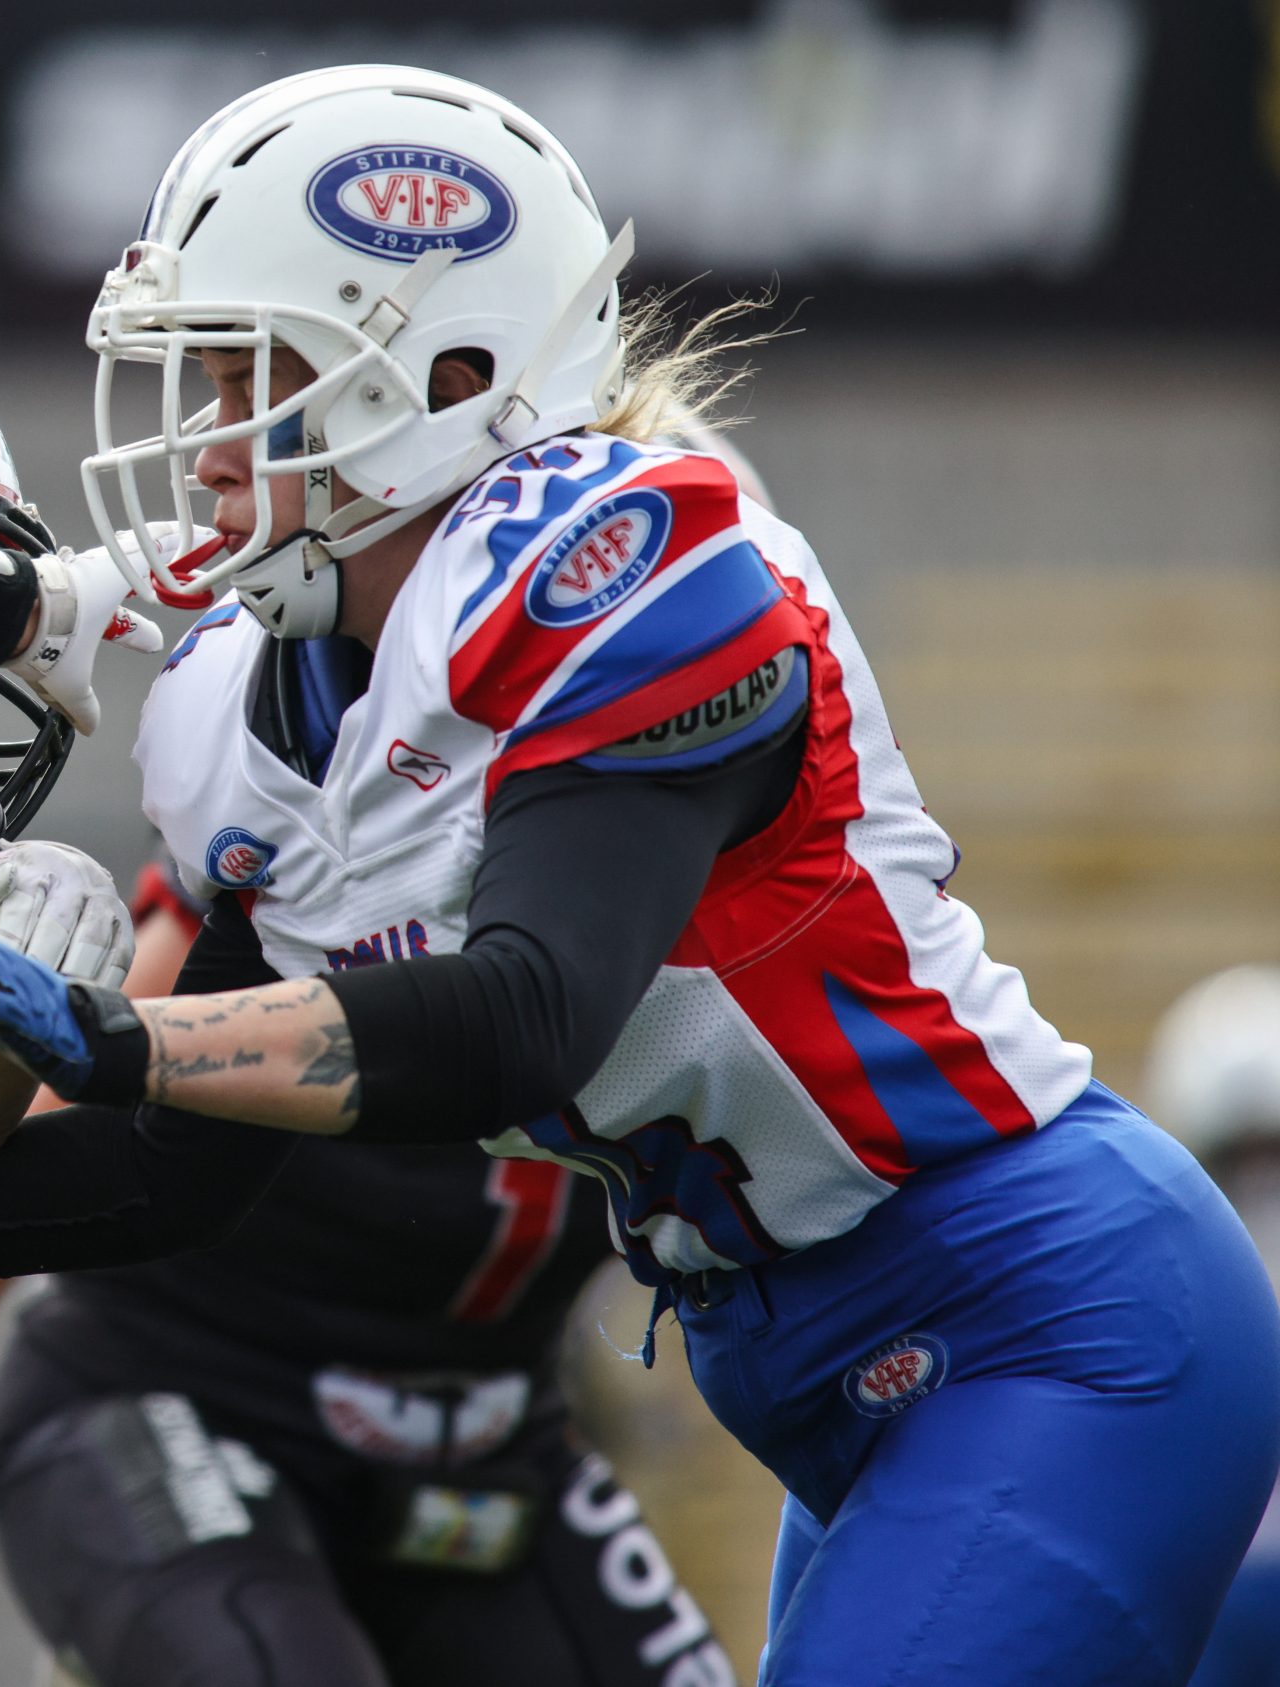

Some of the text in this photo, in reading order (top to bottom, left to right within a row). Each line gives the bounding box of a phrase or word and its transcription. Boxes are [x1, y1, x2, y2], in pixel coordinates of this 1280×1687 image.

[355, 151, 470, 178] STIFTET
[541, 499, 617, 574] STIFTET
[615, 657, 780, 746] OUGLAS
